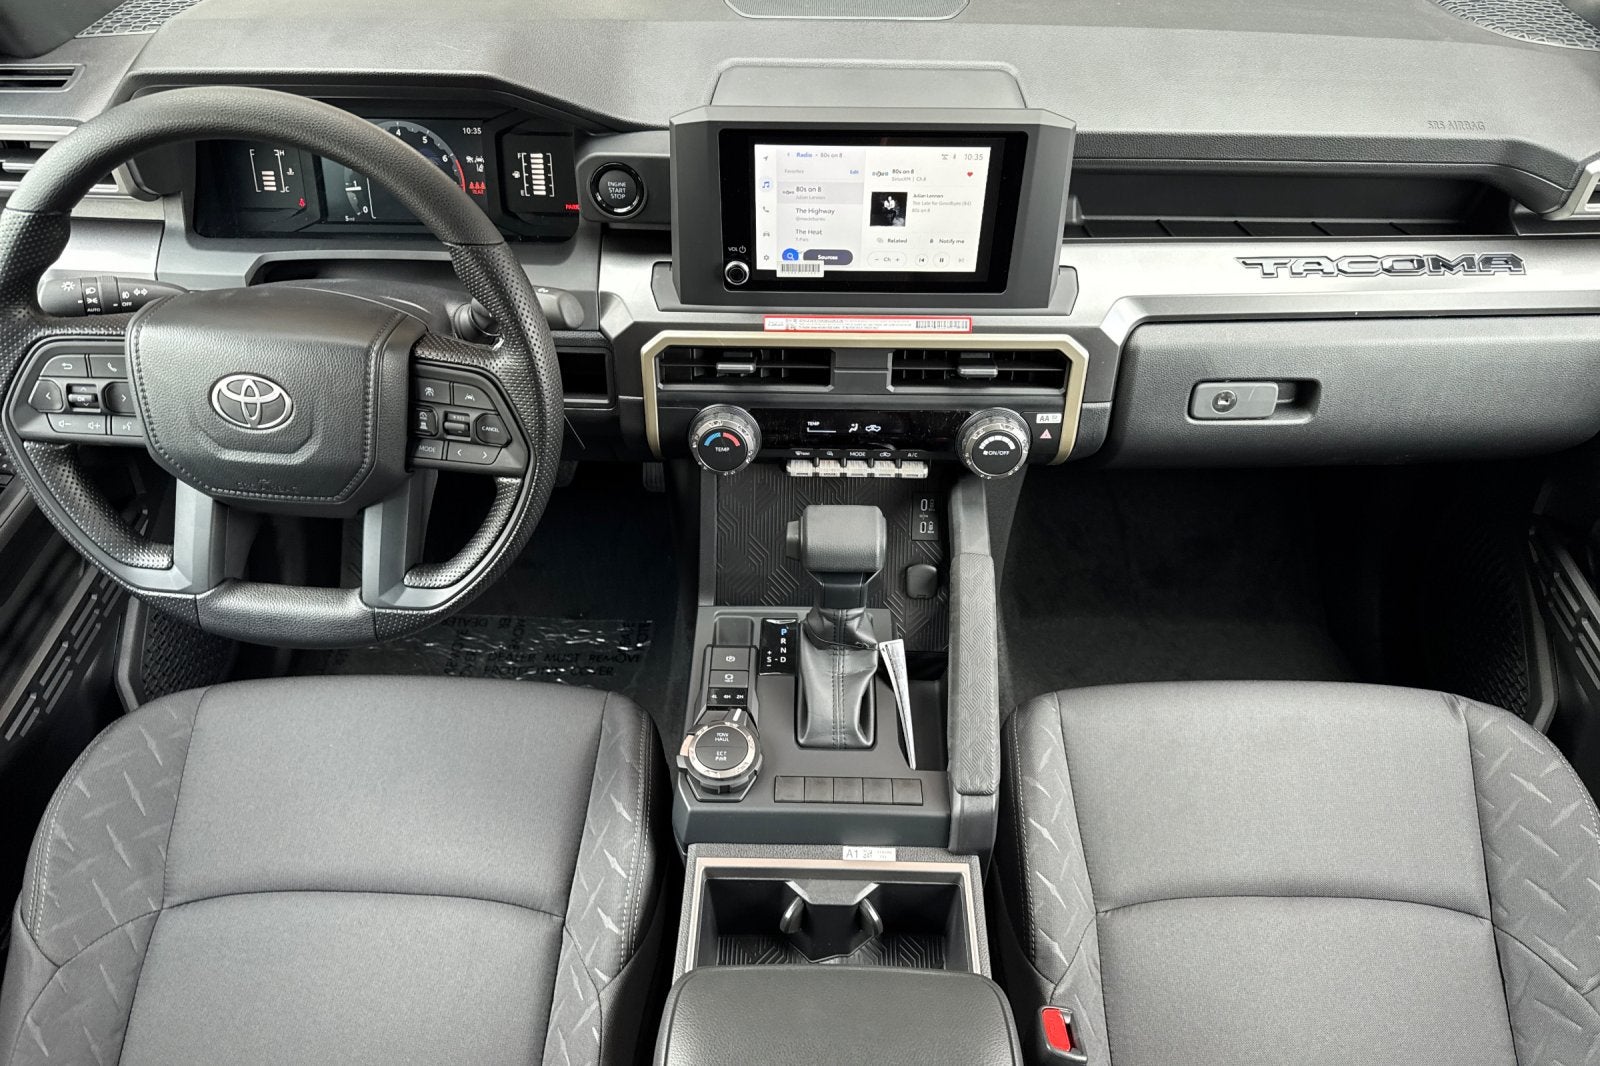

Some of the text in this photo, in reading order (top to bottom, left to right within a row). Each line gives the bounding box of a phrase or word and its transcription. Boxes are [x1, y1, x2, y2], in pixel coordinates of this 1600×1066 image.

[1427, 120, 1486, 131] SRS AIRBAG
[1233, 252, 1527, 278] TACOMA
[418, 445, 436, 453] MODE
[544, 652, 581, 662] MUST
[846, 850, 859, 858] A1
